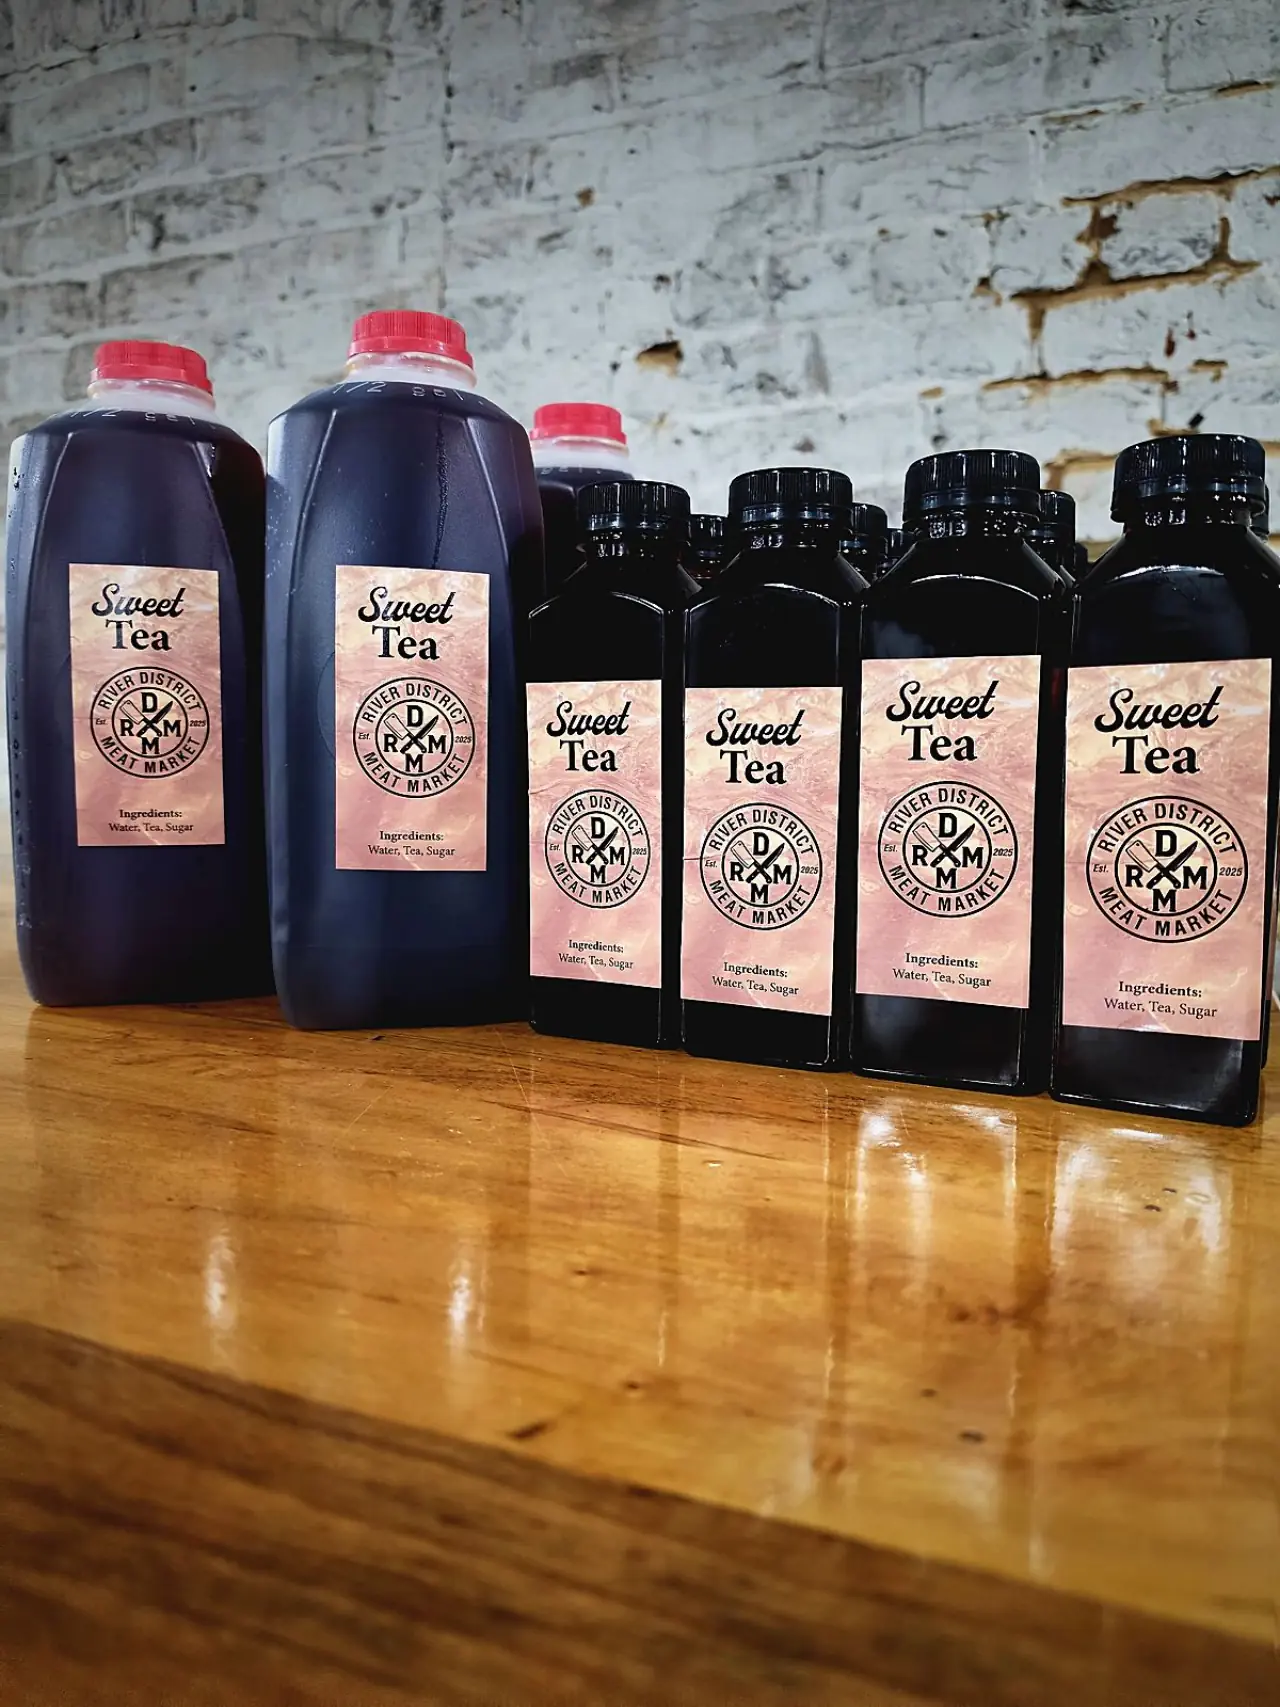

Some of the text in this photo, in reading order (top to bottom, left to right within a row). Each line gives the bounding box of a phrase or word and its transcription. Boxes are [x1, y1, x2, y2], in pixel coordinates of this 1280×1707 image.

[91, 583, 186, 619] Sweet
[358, 586, 456, 625] Sweet
[105, 619, 173, 651] Tea
[372, 625, 440, 660] Tea
[98, 671, 202, 711] RIVER DISTRICT
[141, 692, 158, 713] D
[886, 680, 1000, 722] Sweet
[362, 683, 467, 725] RIVER DISTRICT
[1094, 686, 1224, 733] Sweet
[120, 719, 182, 738] R M
[406, 705, 423, 728] D
[546, 701, 632, 737] Sweet
[706, 708, 805, 746] Sweet
[141, 737, 160, 755] M
[358, 732, 371, 741] Est.
[383, 733, 447, 754] R M
[455, 734, 473, 744] 2025
[901, 724, 977, 762] Tea
[101, 736, 200, 774] MEAT MARKET
[405, 753, 423, 773] M
[560, 739, 618, 772] Tea
[719, 749, 787, 785] Tea
[1111, 735, 1201, 775] Tea
[362, 751, 465, 793] MEAT MARKET
[119, 809, 183, 820] Ingredients:
[552, 794, 643, 837] RIVER DISTRICT
[888, 788, 1008, 836] RIVER DISTRICT
[109, 823, 194, 833] Water, Tea, Sugar
[379, 831, 444, 842] Ingredients:
[590, 816, 606, 839] D
[709, 809, 815, 855] RIVER DISTRICT
[938, 812, 958, 838] D
[1097, 803, 1238, 854] RIVER DISTRICT
[368, 845, 456, 857] Water, Tea, Sugar
[571, 844, 625, 866] R M
[752, 831, 770, 856] D
[884, 844, 898, 853] Est.
[993, 847, 1014, 858] 2025
[1154, 829, 1178, 858] D
[704, 858, 718, 868] Est.
[911, 845, 984, 870] R M
[1092, 863, 1110, 873] Est.
[590, 864, 606, 884] M
[729, 861, 792, 886] R M
[800, 865, 819, 875] 2025
[935, 867, 957, 890] M
[1125, 865, 1208, 891] R M
[1218, 866, 1244, 877] 2025
[554, 862, 641, 904] MEAT MARKET
[750, 883, 769, 905] M
[889, 865, 1005, 912] MEAT MARKET
[709, 880, 811, 925] MEAT MARKET
[1099, 887, 1233, 937] MEAT MARKET
[1152, 888, 1177, 913] M
[568, 939, 624, 953] Ingredients:
[558, 953, 634, 970] Water, Tea, Sugar
[723, 962, 788, 978] Ingredients:
[905, 952, 979, 968] Ingredients:
[712, 976, 800, 997] Water, Tea, Sugar
[892, 968, 992, 989] Water, Tea, Sugar
[1118, 981, 1202, 998] Ingredients:
[1104, 998, 1218, 1020] Water, Tea, Sugar
